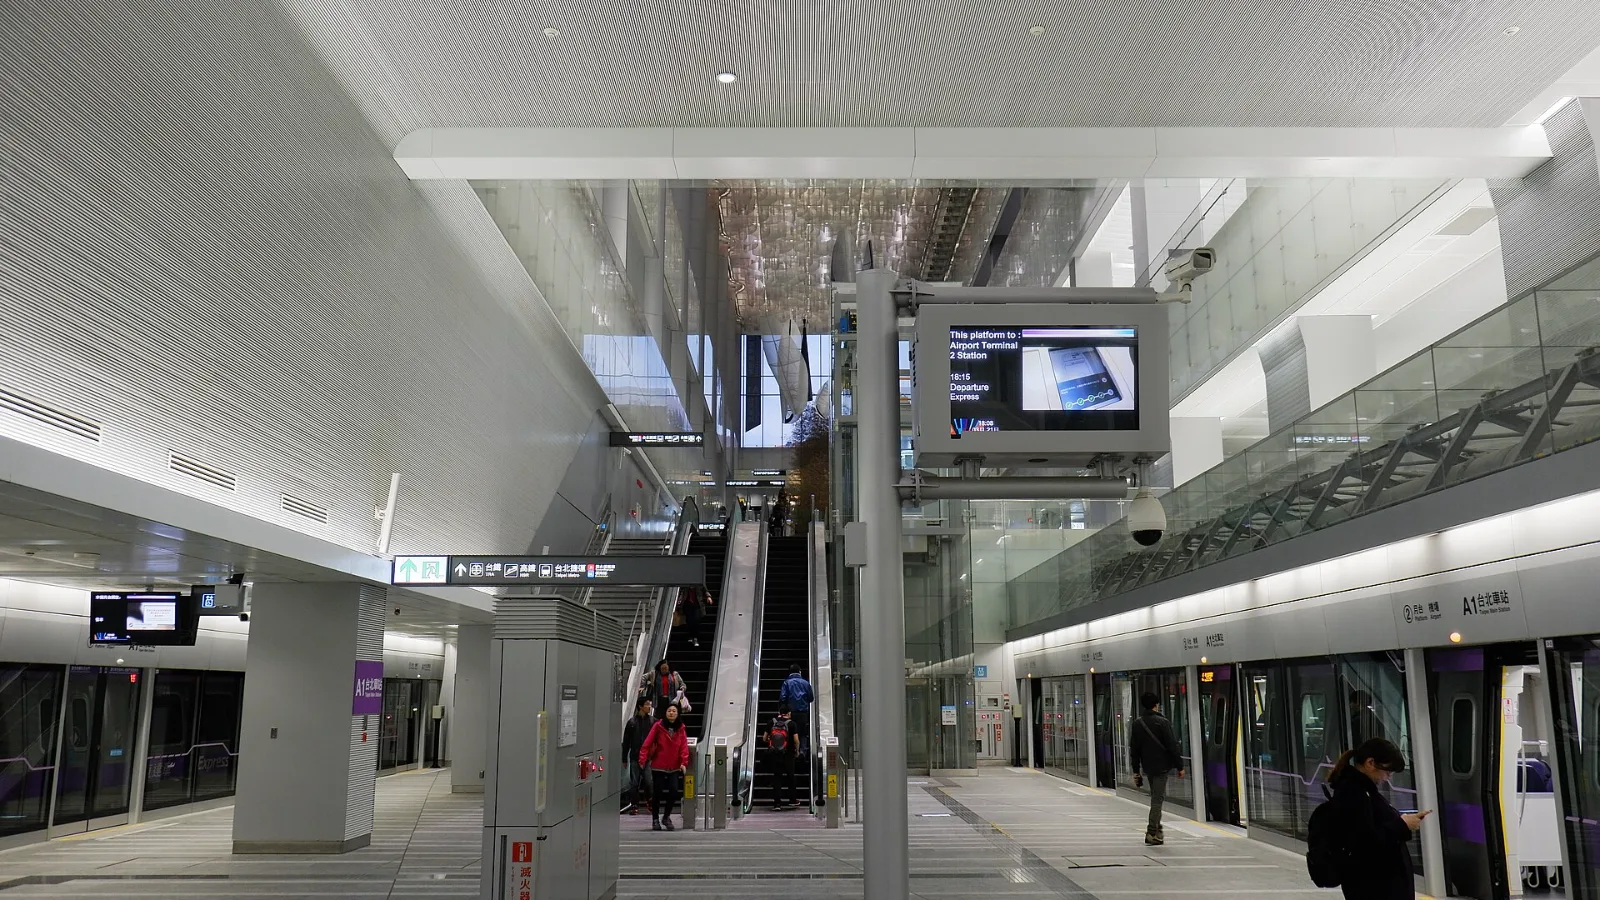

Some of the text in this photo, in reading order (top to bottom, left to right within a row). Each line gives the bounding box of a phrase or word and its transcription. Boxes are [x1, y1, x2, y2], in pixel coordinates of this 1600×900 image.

[950, 330, 968, 339] This
[970, 330, 1005, 341] platform
[1007, 331, 1016, 339] to
[950, 341, 1018, 351] Airport Terminal
[957, 351, 987, 360] Station
[950, 383, 989, 392] Departure
[950, 393, 979, 402] Express
[1463, 590, 1510, 616] A1 台北車站
[1414, 604, 1424, 614] 月台
[355, 678, 365, 696] A1
